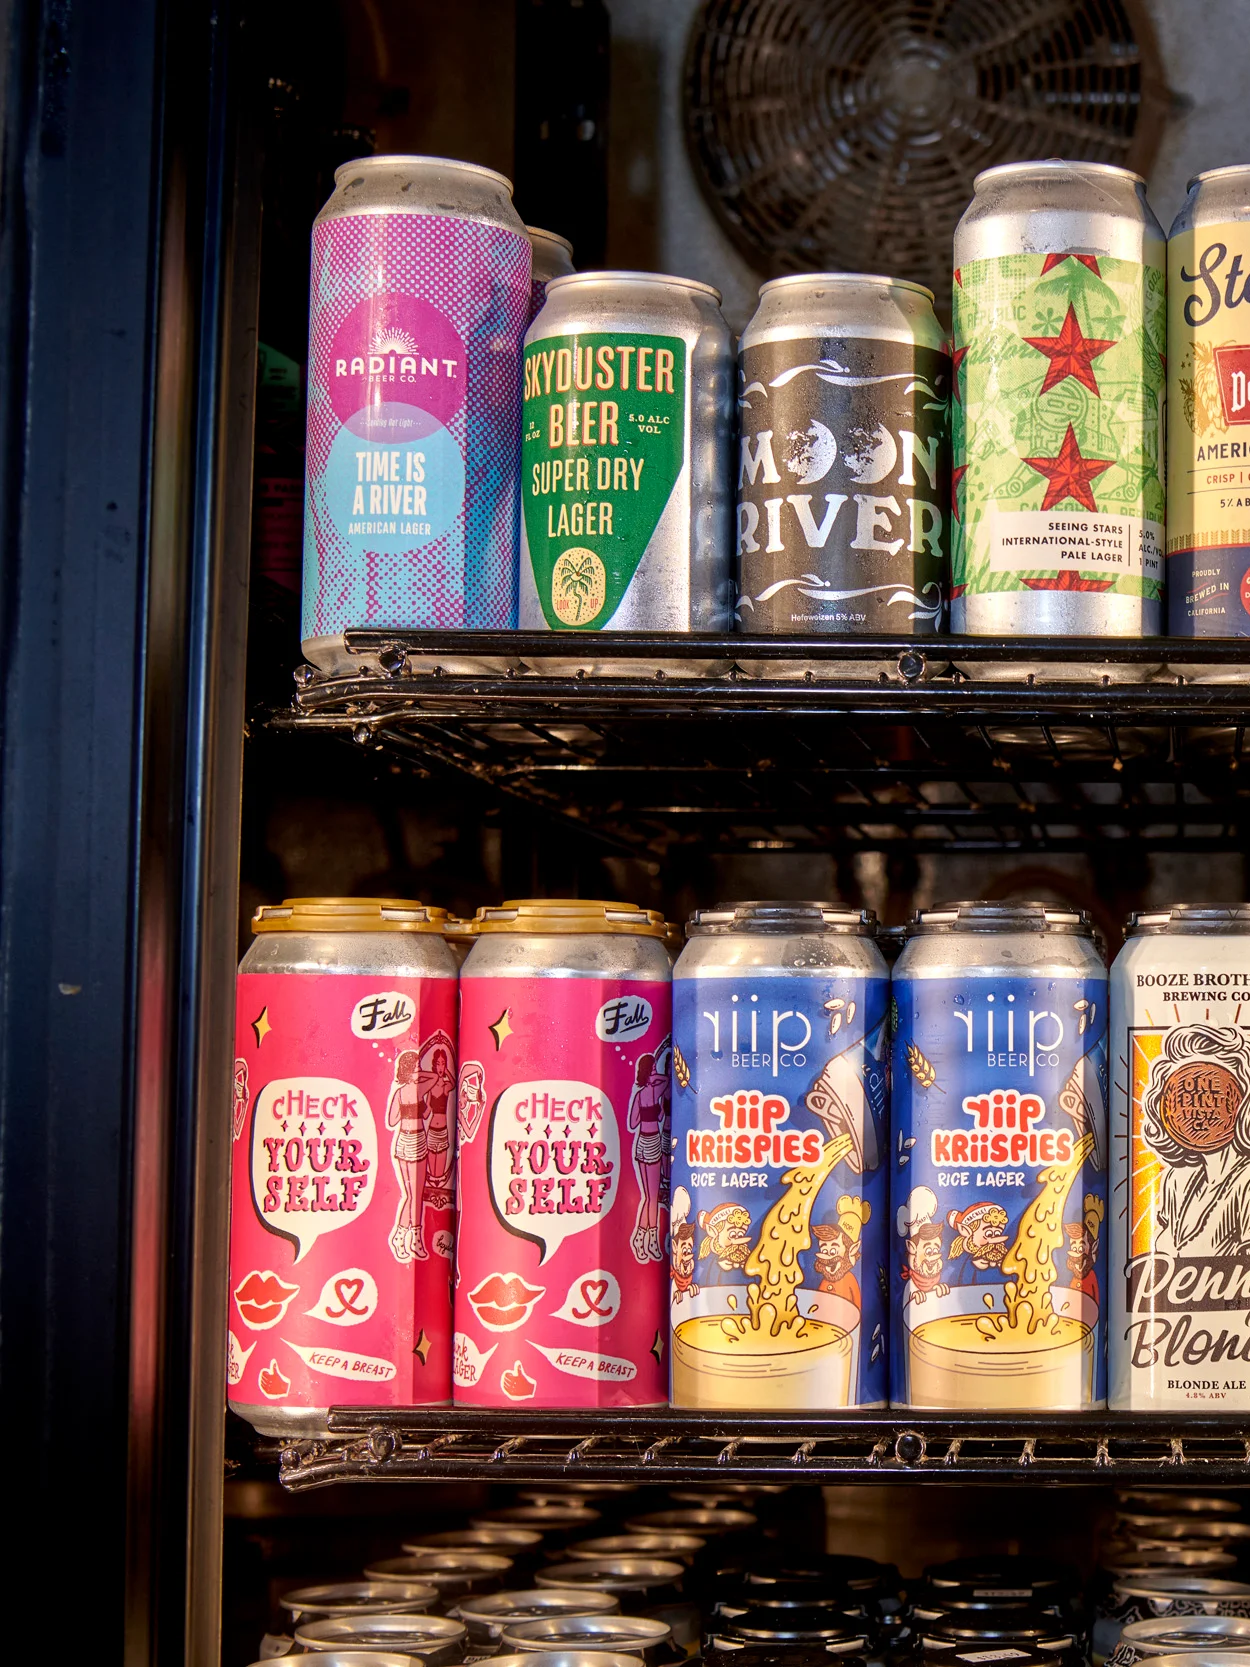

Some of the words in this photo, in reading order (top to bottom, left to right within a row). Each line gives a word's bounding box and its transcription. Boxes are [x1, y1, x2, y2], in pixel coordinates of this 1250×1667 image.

[400, 375, 417, 383] CO.
[524, 346, 674, 401] SKYDUSTER
[549, 401, 619, 449] BEER
[648, 415, 670, 424] ALC
[638, 425, 661, 434] VOL
[356, 451, 400, 482] TIME
[406, 451, 426, 482] IS
[532, 458, 589, 496] SUPER
[597, 457, 645, 491] DRY
[1207, 474, 1235, 485] CRISP
[352, 485, 365, 516] A
[370, 485, 427, 516] RIVER
[1220, 498, 1234, 508] 5%
[548, 502, 613, 537] LAGER
[736, 494, 943, 557] RIVER
[348, 522, 396, 535] AMERICAN
[400, 522, 431, 536] LAGER
[1048, 522, 1088, 532] SEEING
[1093, 524, 1123, 535] STARS
[1138, 530, 1155, 541] 5.0%
[1002, 536, 1123, 549] INTERNATIONAL-STYLE
[1061, 551, 1087, 560] PALE
[1091, 552, 1123, 563] LAGER
[1145, 559, 1158, 570] PINT
[1192, 568, 1221, 578] PROUDLY
[1185, 584, 1217, 604] BREWED
[1219, 582, 1230, 591] IN
[556, 600, 570, 610] LOOK
[590, 598, 598, 608] UP
[791, 613, 834, 622] Hefeweizen
[835, 613, 848, 622] 5%
[849, 613, 866, 622] ABV
[1187, 607, 1226, 617] CALIFORNIA
[1137, 974, 1189, 987] BOOZE
[1163, 991, 1227, 1002] BREWING
[359, 998, 412, 1031] Fall
[603, 1001, 650, 1034] Fall
[732, 1054, 770, 1067] BEER
[780, 1053, 807, 1068] CO
[988, 1053, 1028, 1067] BEER
[1036, 1053, 1060, 1067] CO
[1184, 1076, 1222, 1093] ONE
[1181, 1092, 1225, 1108] PINT
[1182, 1109, 1221, 1120] VISTA
[263, 1136, 371, 1173] YOUR
[505, 1139, 614, 1175] YOUR
[691, 1172, 717, 1187] RICE
[722, 1172, 768, 1188] LAGER
[938, 1172, 970, 1187] RICE
[976, 1172, 1025, 1187] LAGER
[263, 1174, 368, 1213] SELF
[505, 1177, 612, 1215] SELF
[309, 1352, 340, 1368] KEEP
[341, 1360, 348, 1370] A
[352, 1360, 393, 1378] BREAST
[556, 1352, 587, 1366] KEEP
[587, 1361, 594, 1371] A
[598, 1361, 635, 1377] BREAST
[1167, 1380, 1219, 1390] BLONDE
[1223, 1380, 1247, 1390] ALE
